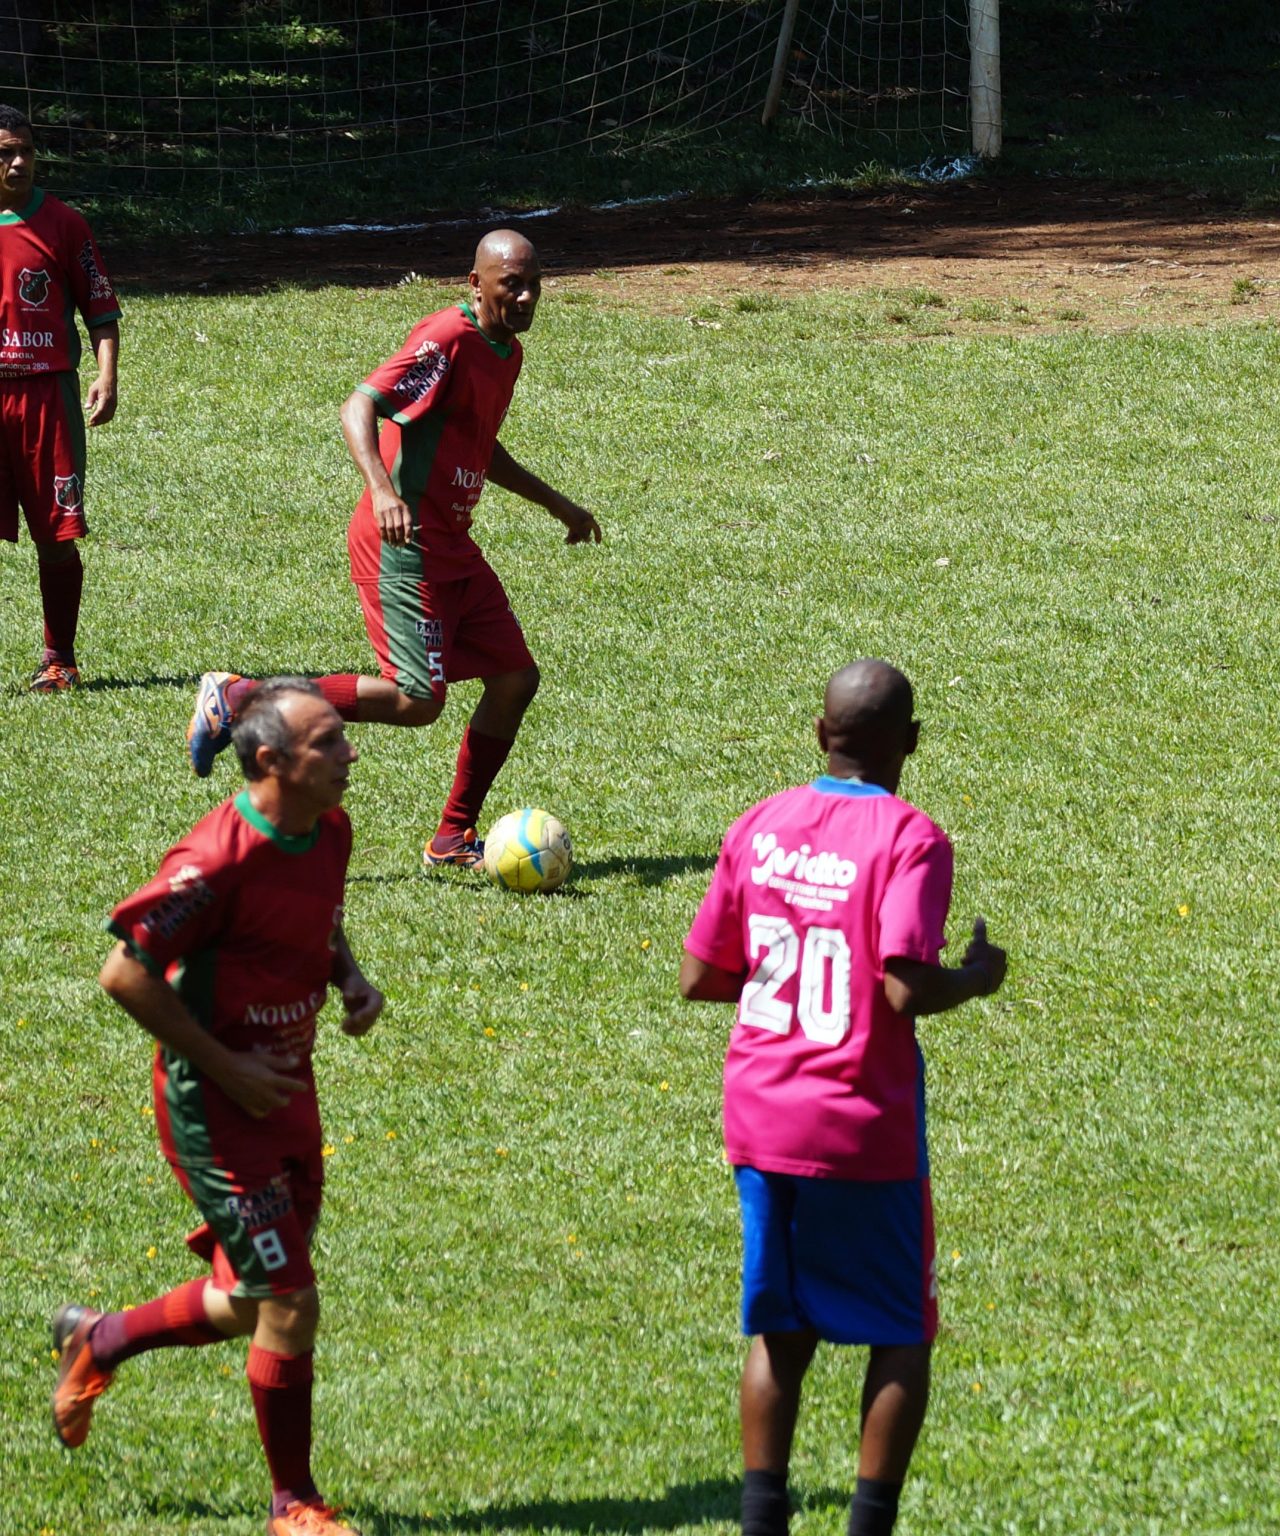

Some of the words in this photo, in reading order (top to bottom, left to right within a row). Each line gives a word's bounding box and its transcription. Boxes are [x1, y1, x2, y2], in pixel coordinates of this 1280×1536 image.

[2, 328, 54, 348] SABOR
[394, 362, 428, 396] FRAN
[408, 355, 450, 403] TINTAS
[416, 620, 442, 634] FRA
[428, 652, 444, 682] 5
[739, 913, 851, 1048] 20
[243, 1001, 306, 1027] NOVO
[252, 1228, 288, 1272] 8
